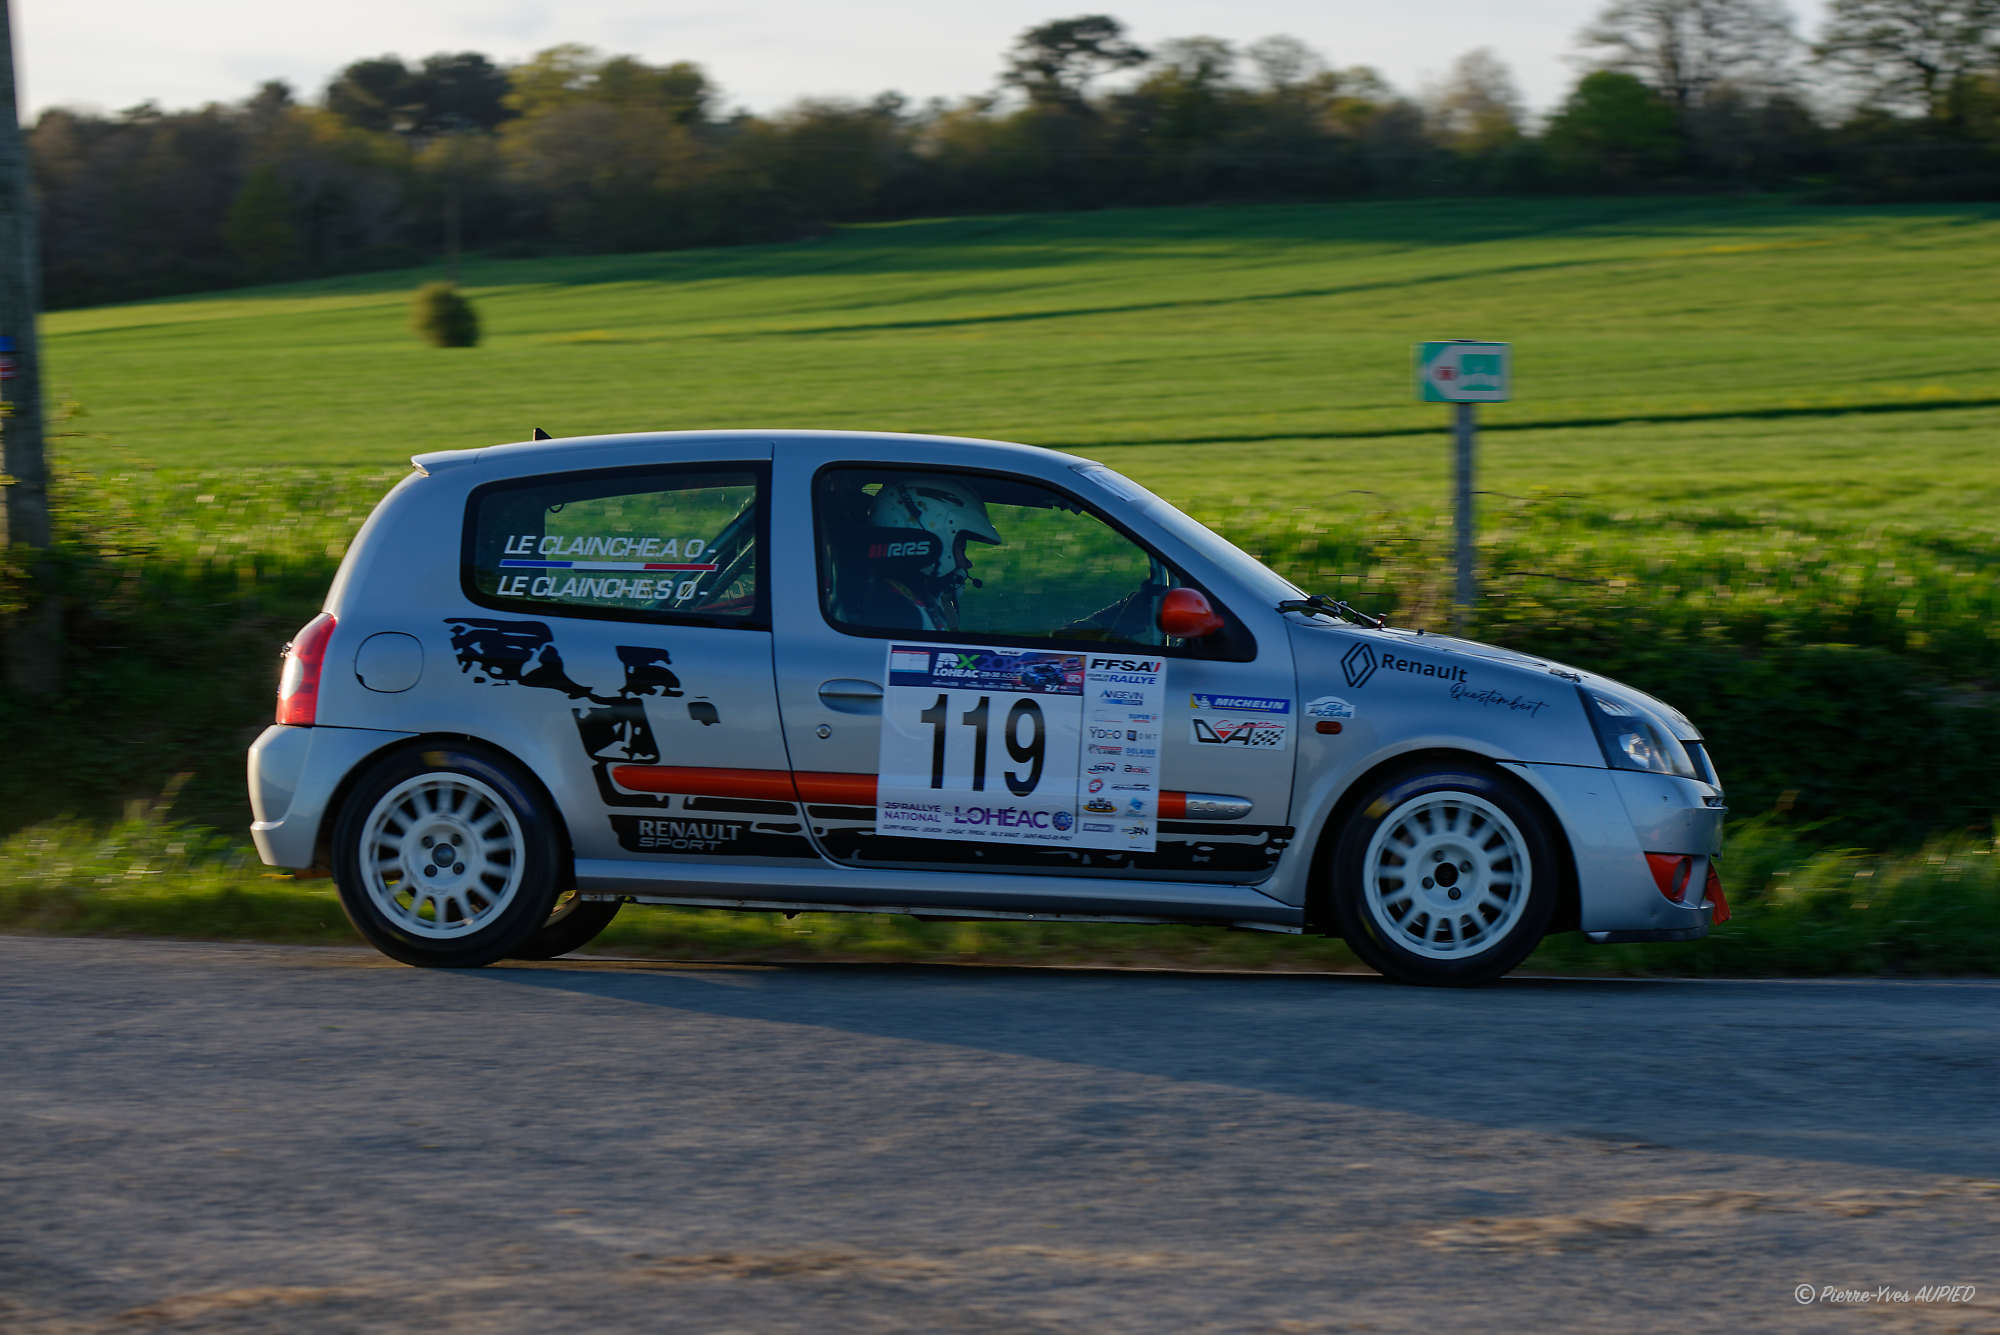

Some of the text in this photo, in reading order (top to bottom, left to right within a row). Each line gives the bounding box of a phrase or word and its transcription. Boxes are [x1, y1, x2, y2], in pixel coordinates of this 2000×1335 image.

[504, 536, 537, 555] LE
[496, 576, 529, 596] LE
[1091, 658, 1153, 673] FFSA
[1381, 653, 1469, 682] Renault
[1109, 675, 1157, 685] RALLYE
[1214, 697, 1287, 710] MICHELIN
[920, 694, 1046, 798] 119
[884, 811, 941, 823] NATIONAL
[954, 806, 1049, 829] LOHÉAC
[639, 820, 743, 841] RENAULT
[639, 837, 722, 851] SPORT
